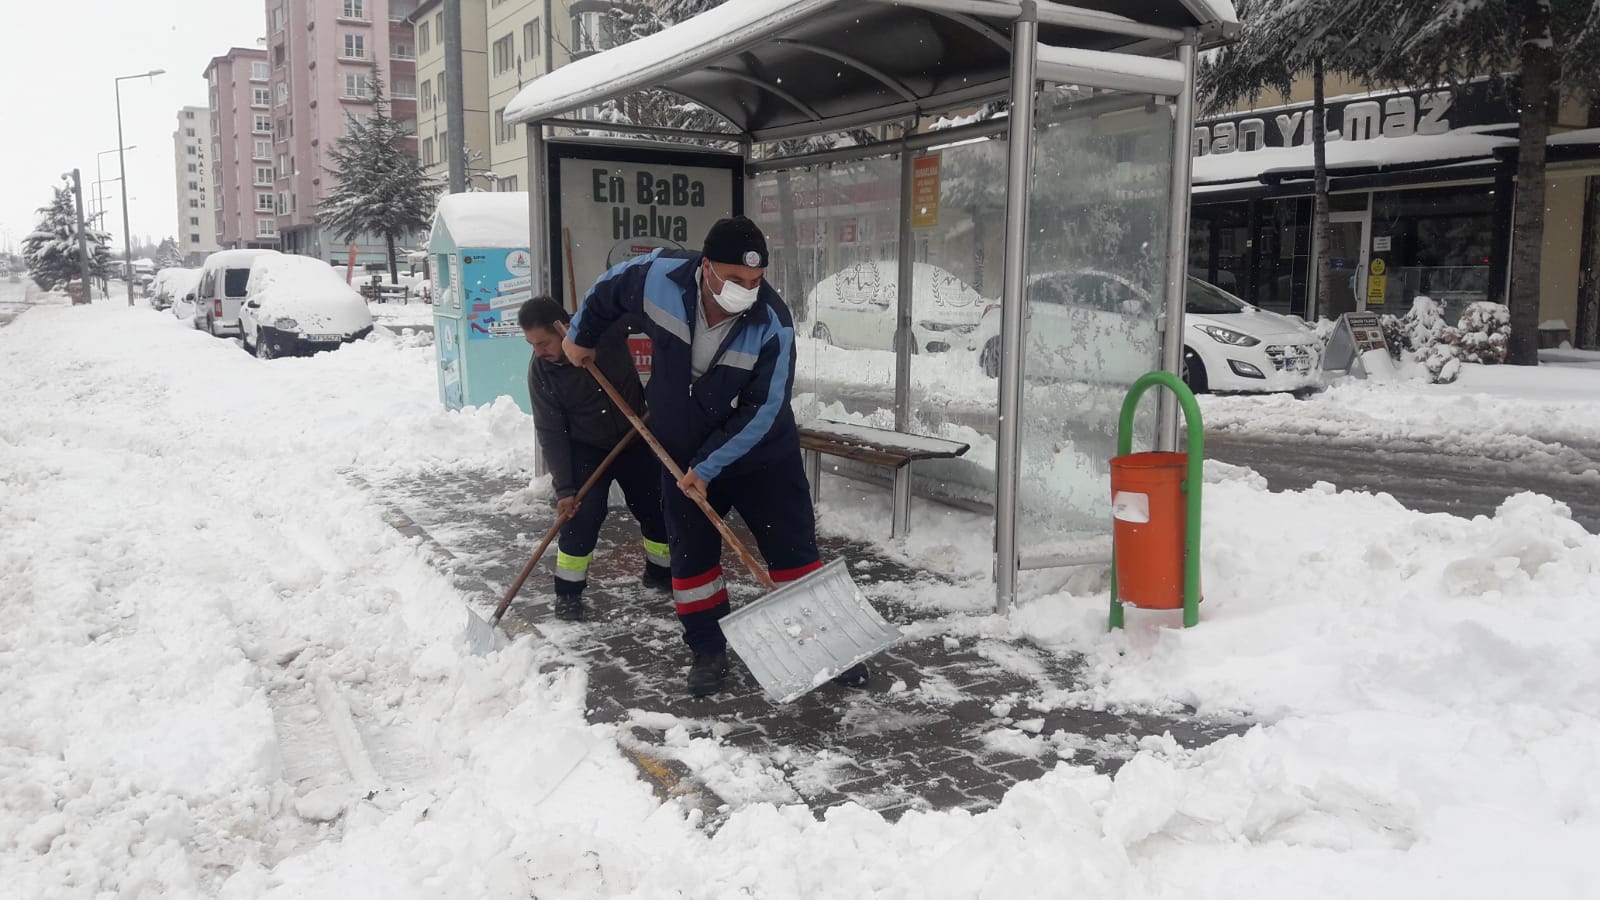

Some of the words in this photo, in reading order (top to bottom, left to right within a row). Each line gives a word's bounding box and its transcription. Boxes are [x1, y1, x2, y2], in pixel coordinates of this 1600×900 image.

[592, 168, 625, 203] En
[636, 170, 705, 207] BaBa
[612, 205, 688, 242] Helva
